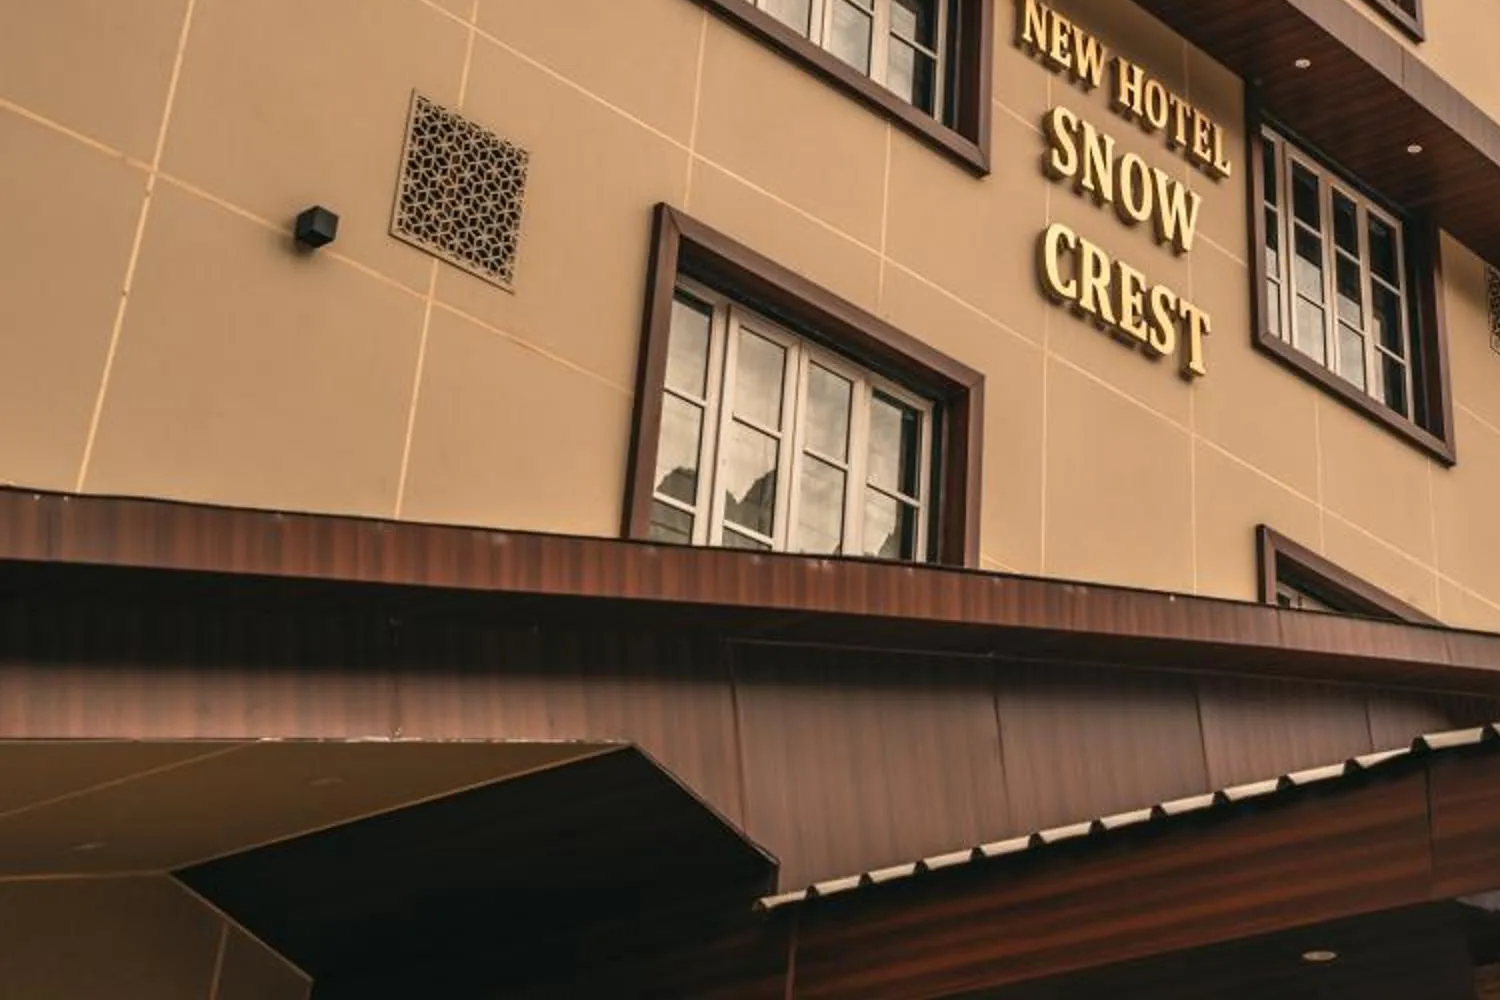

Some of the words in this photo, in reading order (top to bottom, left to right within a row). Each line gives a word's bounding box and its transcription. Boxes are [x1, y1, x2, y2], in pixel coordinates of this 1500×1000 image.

[1046, 104, 1204, 253] SNOW
[1114, 56, 1232, 178] HOTEL
[1040, 222, 1212, 376] CREST
